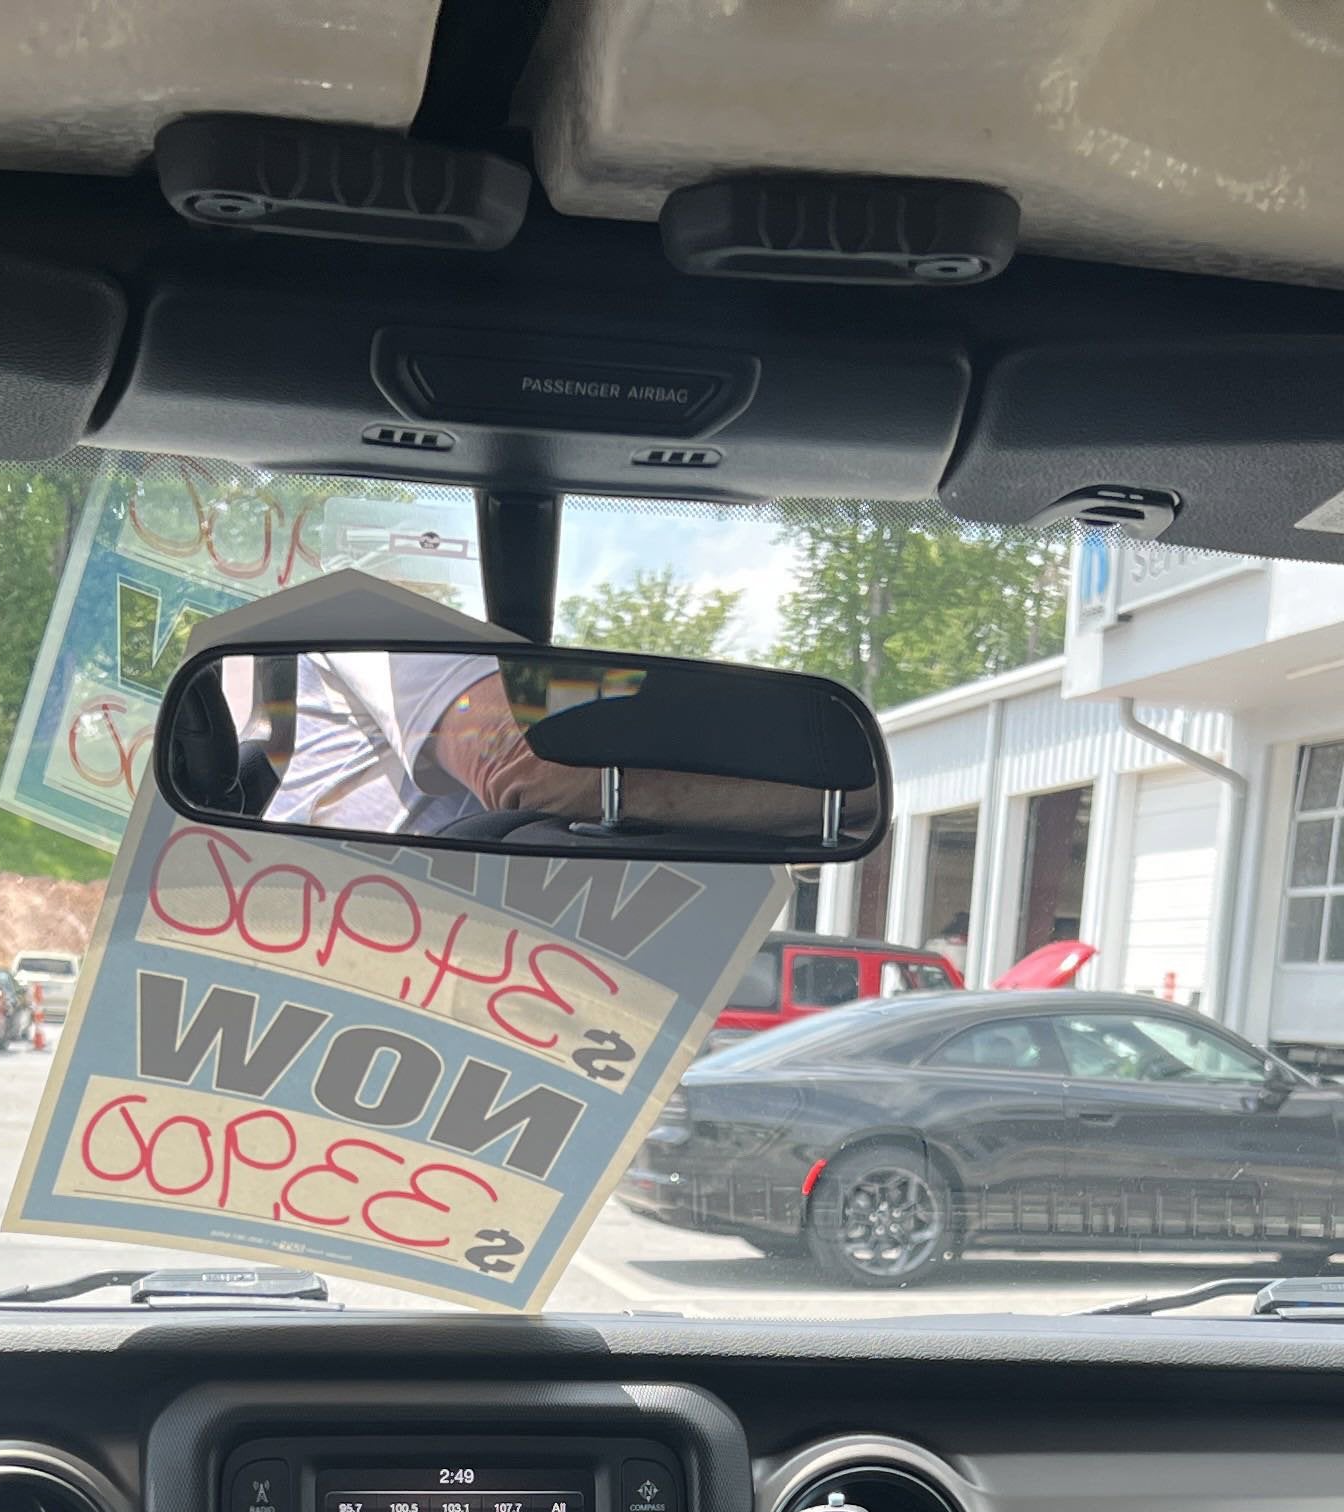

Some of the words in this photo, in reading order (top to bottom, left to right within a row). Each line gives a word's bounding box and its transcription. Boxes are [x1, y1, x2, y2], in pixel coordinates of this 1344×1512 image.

[522, 376, 620, 398] PASSENGER
[627, 385, 688, 404] AIRBAG
[439, 1469, 475, 1484] 2:49
[629, 1504, 665, 1512] COMPASS
